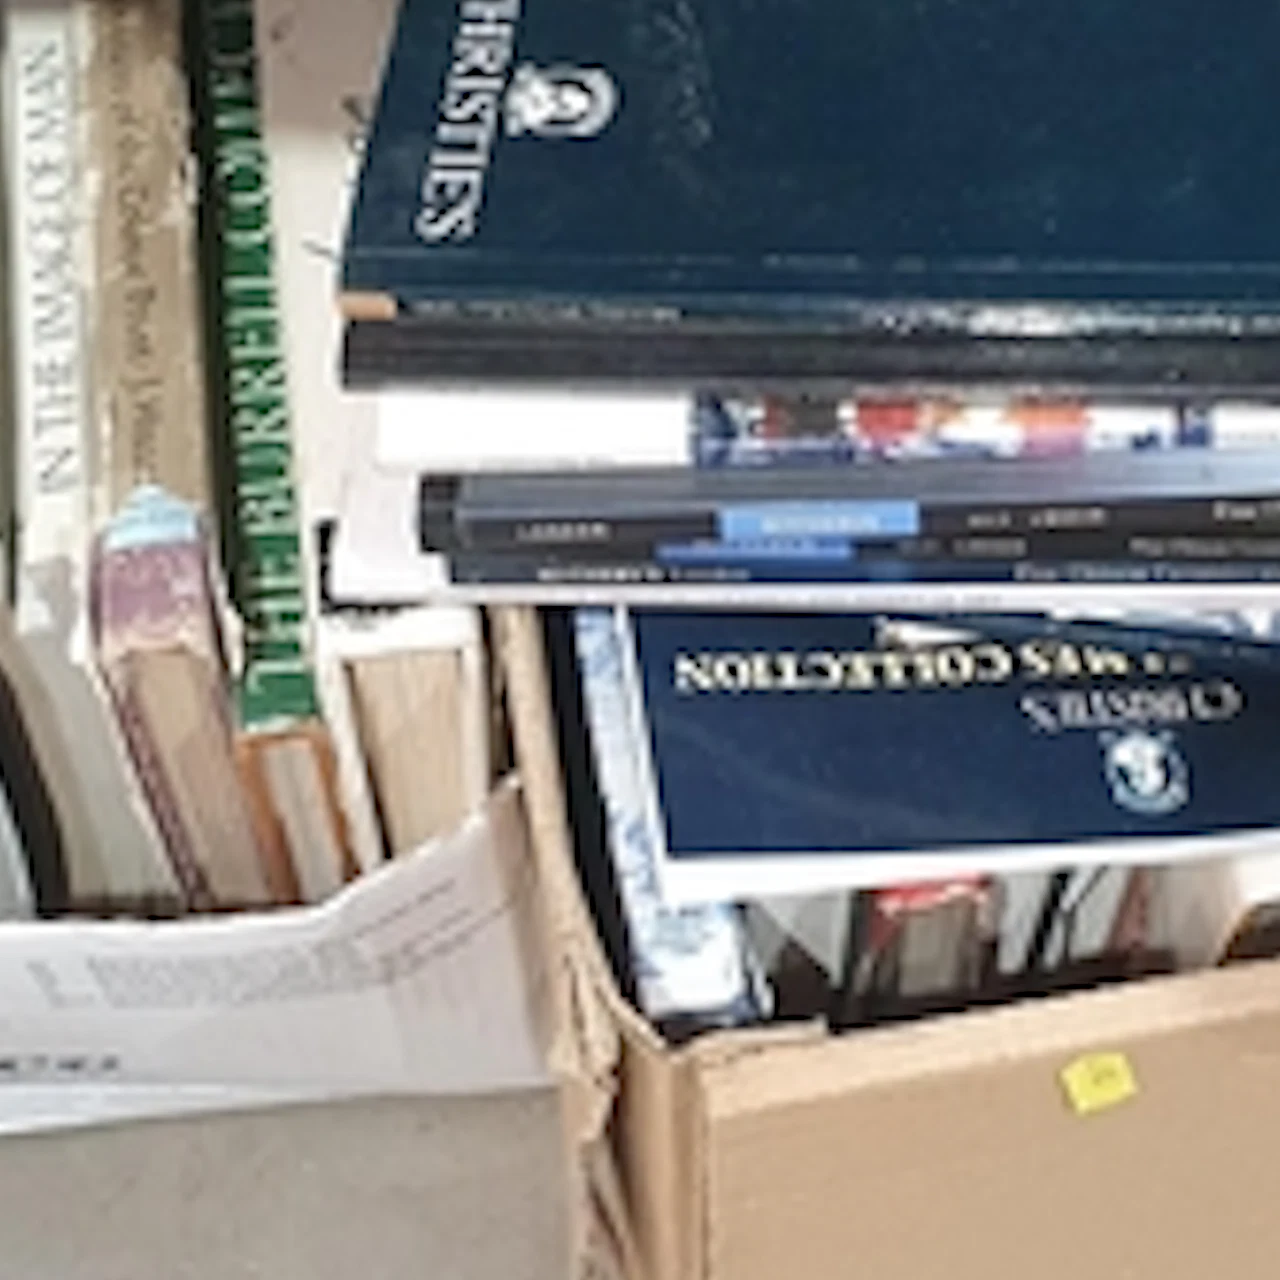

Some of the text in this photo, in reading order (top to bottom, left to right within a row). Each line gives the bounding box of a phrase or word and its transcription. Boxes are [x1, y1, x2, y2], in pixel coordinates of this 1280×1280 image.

[23, 38, 64, 146] MAN
[33, 356, 76, 435] THE
[222, 260, 302, 536] BURRELL
[241, 548, 312, 702] THE
[671, 642, 1014, 695] COLLECTION
